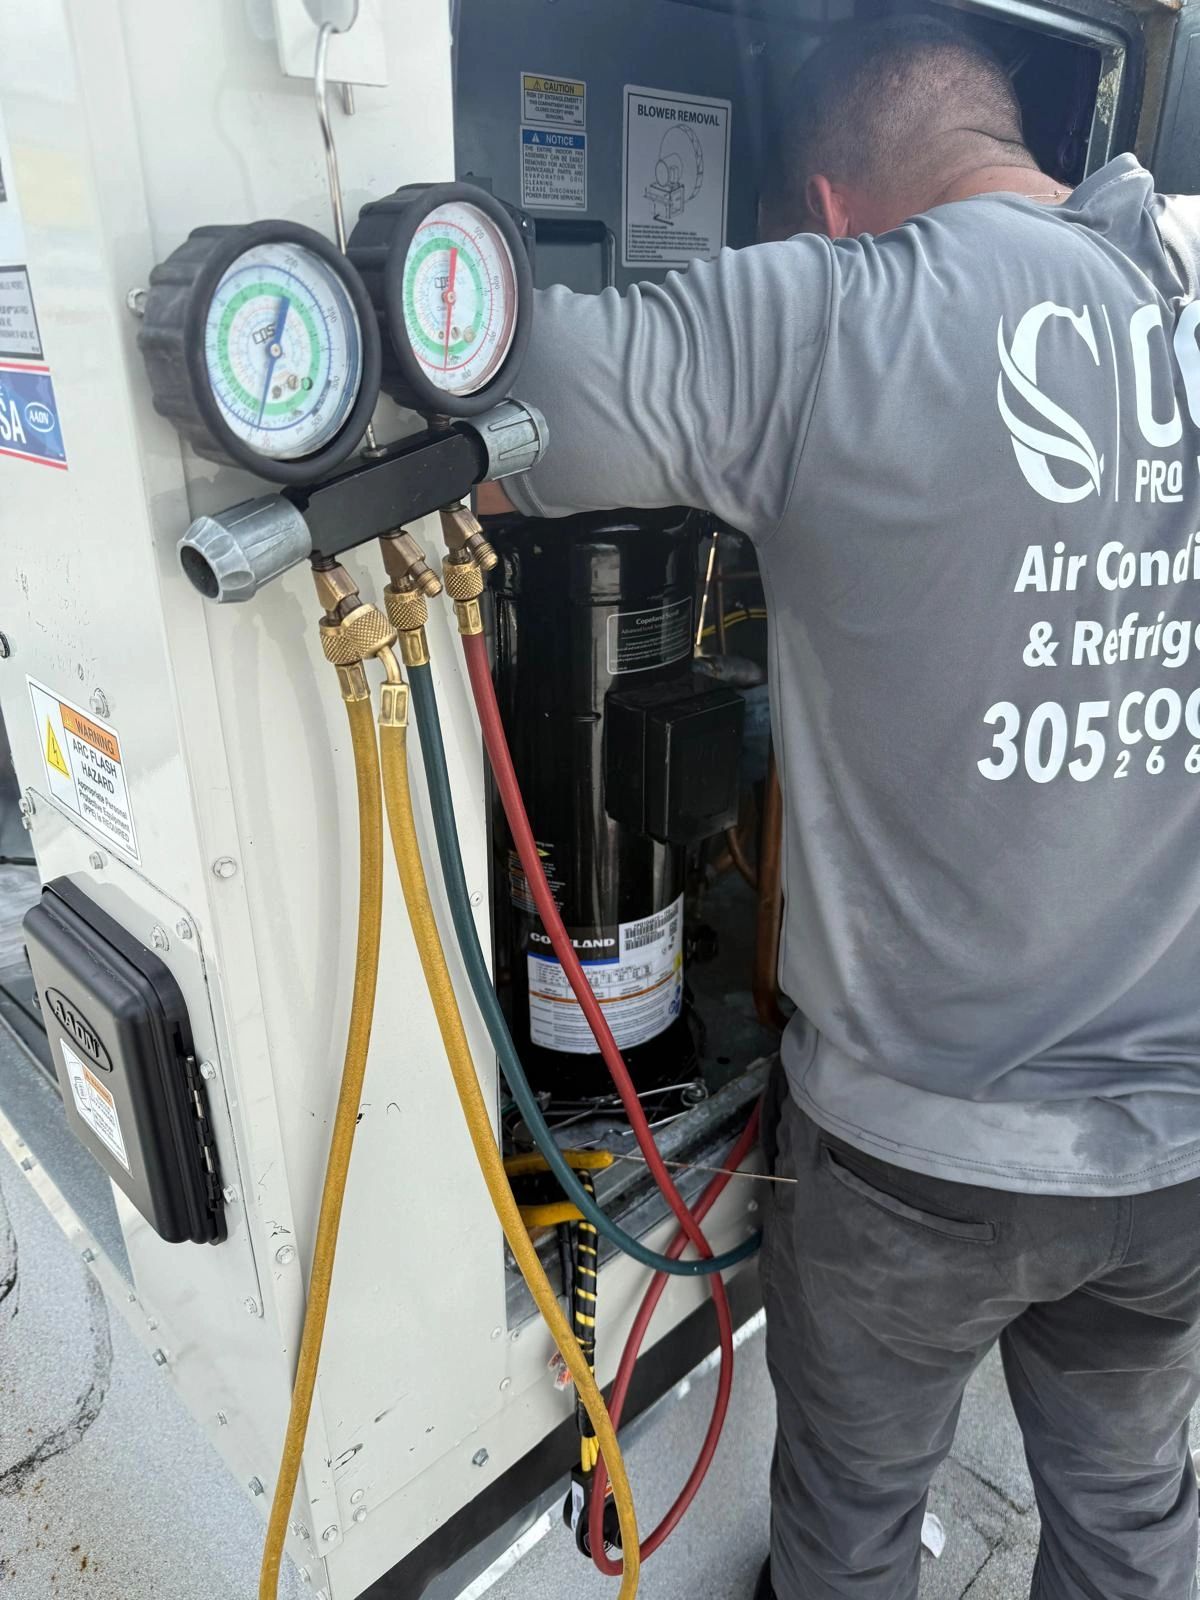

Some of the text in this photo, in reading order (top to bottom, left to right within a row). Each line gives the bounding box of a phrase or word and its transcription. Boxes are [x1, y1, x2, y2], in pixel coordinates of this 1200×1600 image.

[543, 81, 575, 94] CAUTION
[637, 104, 720, 126] BLOWER REMOVAL
[545, 134, 574, 146] NOTICE
[1135, 459, 1184, 503] PRO
[1014, 541, 1088, 593] Air
[1022, 621, 1060, 667] &
[75, 718, 115, 755] WARNING
[977, 700, 1110, 784] 305
[72, 738, 117, 778] ARC FLASH
[78, 777, 105, 804] Appropriate
[81, 761, 114, 794] HAZARD
[530, 932, 616, 948] COLAND
[54, 1000, 99, 1058] AAON
